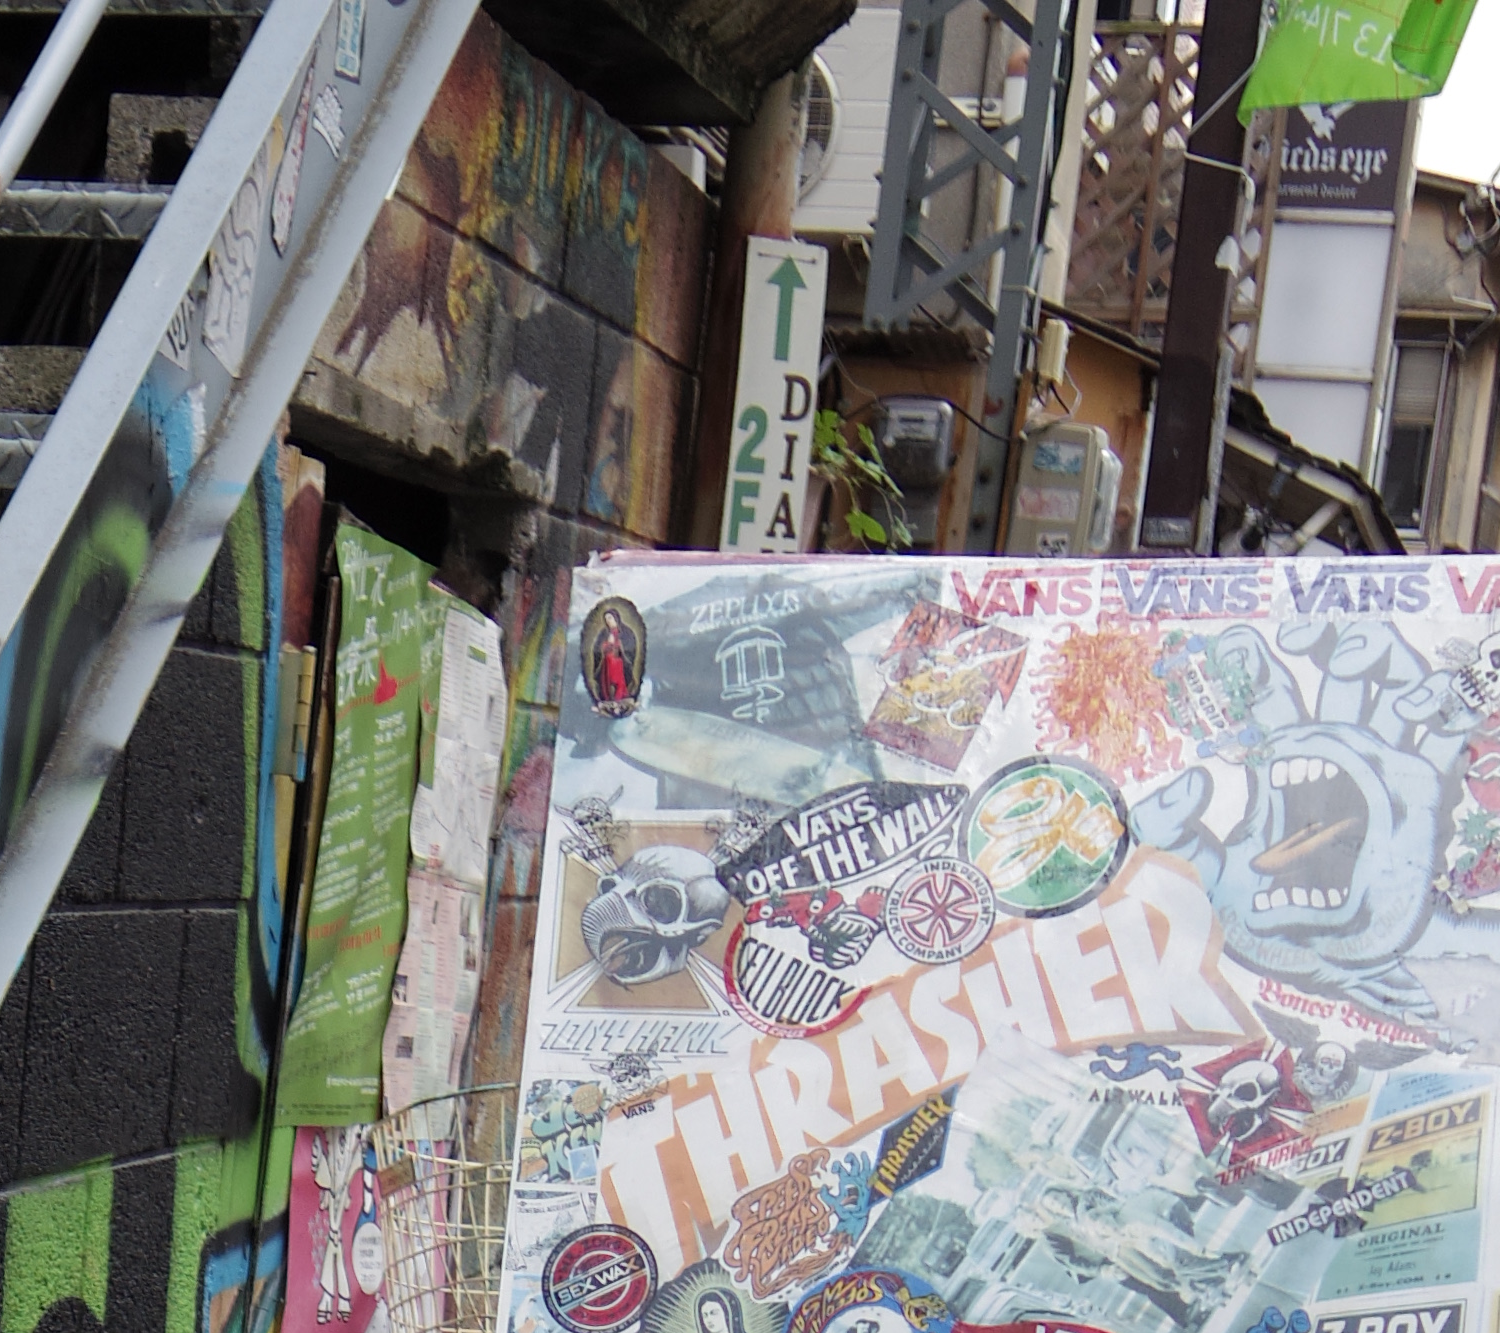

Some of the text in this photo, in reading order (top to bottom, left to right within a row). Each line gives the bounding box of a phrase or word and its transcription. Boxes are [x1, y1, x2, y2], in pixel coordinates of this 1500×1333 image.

[1278, 136, 1337, 174] irds
[728, 404, 769, 546] 2F
[759, 373, 813, 554] DIA
[949, 564, 1094, 618] VANS
[1114, 563, 1261, 619] VANS
[1284, 562, 1432, 614] VANS
[782, 786, 879, 848] VANS
[802, 826, 871, 882] THE
[923, 861, 991, 926] INDEPENDENT
[898, 936, 963, 960] COMPANY
[598, 848, 1260, 1275] THRASHER
[621, 1100, 657, 1120] VANS
[867, 1092, 958, 1198] THRASHER
[1271, 1172, 1412, 1245] INDEPENDENT
[1356, 1221, 1446, 1250] ORIGINAL
[557, 1257, 640, 1305] SEX WAX
